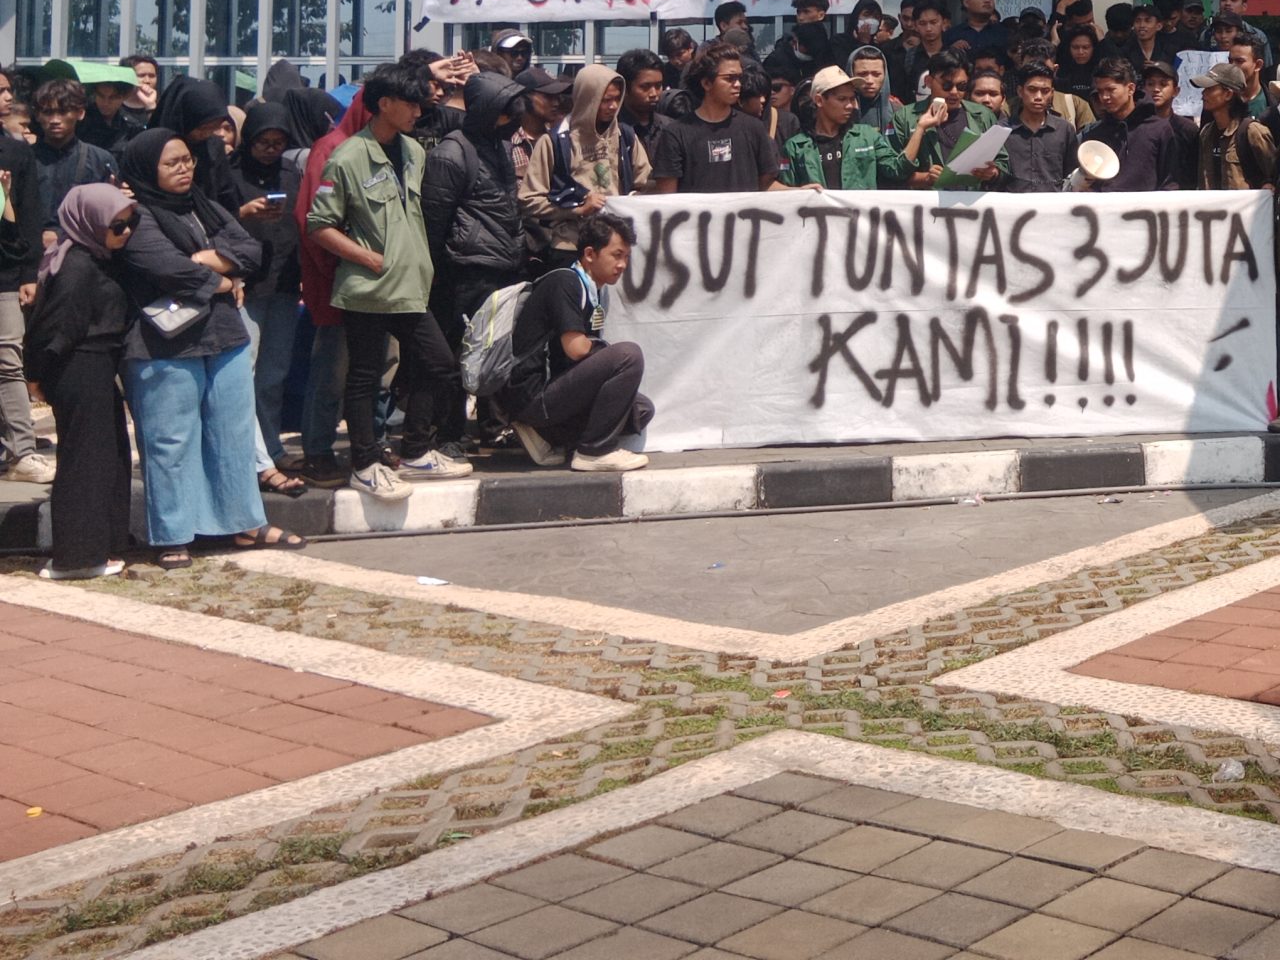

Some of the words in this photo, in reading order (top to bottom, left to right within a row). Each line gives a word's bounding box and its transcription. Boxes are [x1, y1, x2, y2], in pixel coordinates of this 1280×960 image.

[623, 208, 785, 309] USUT
[798, 204, 1056, 303] TUNTAS
[1116, 208, 1259, 284] JUTA
